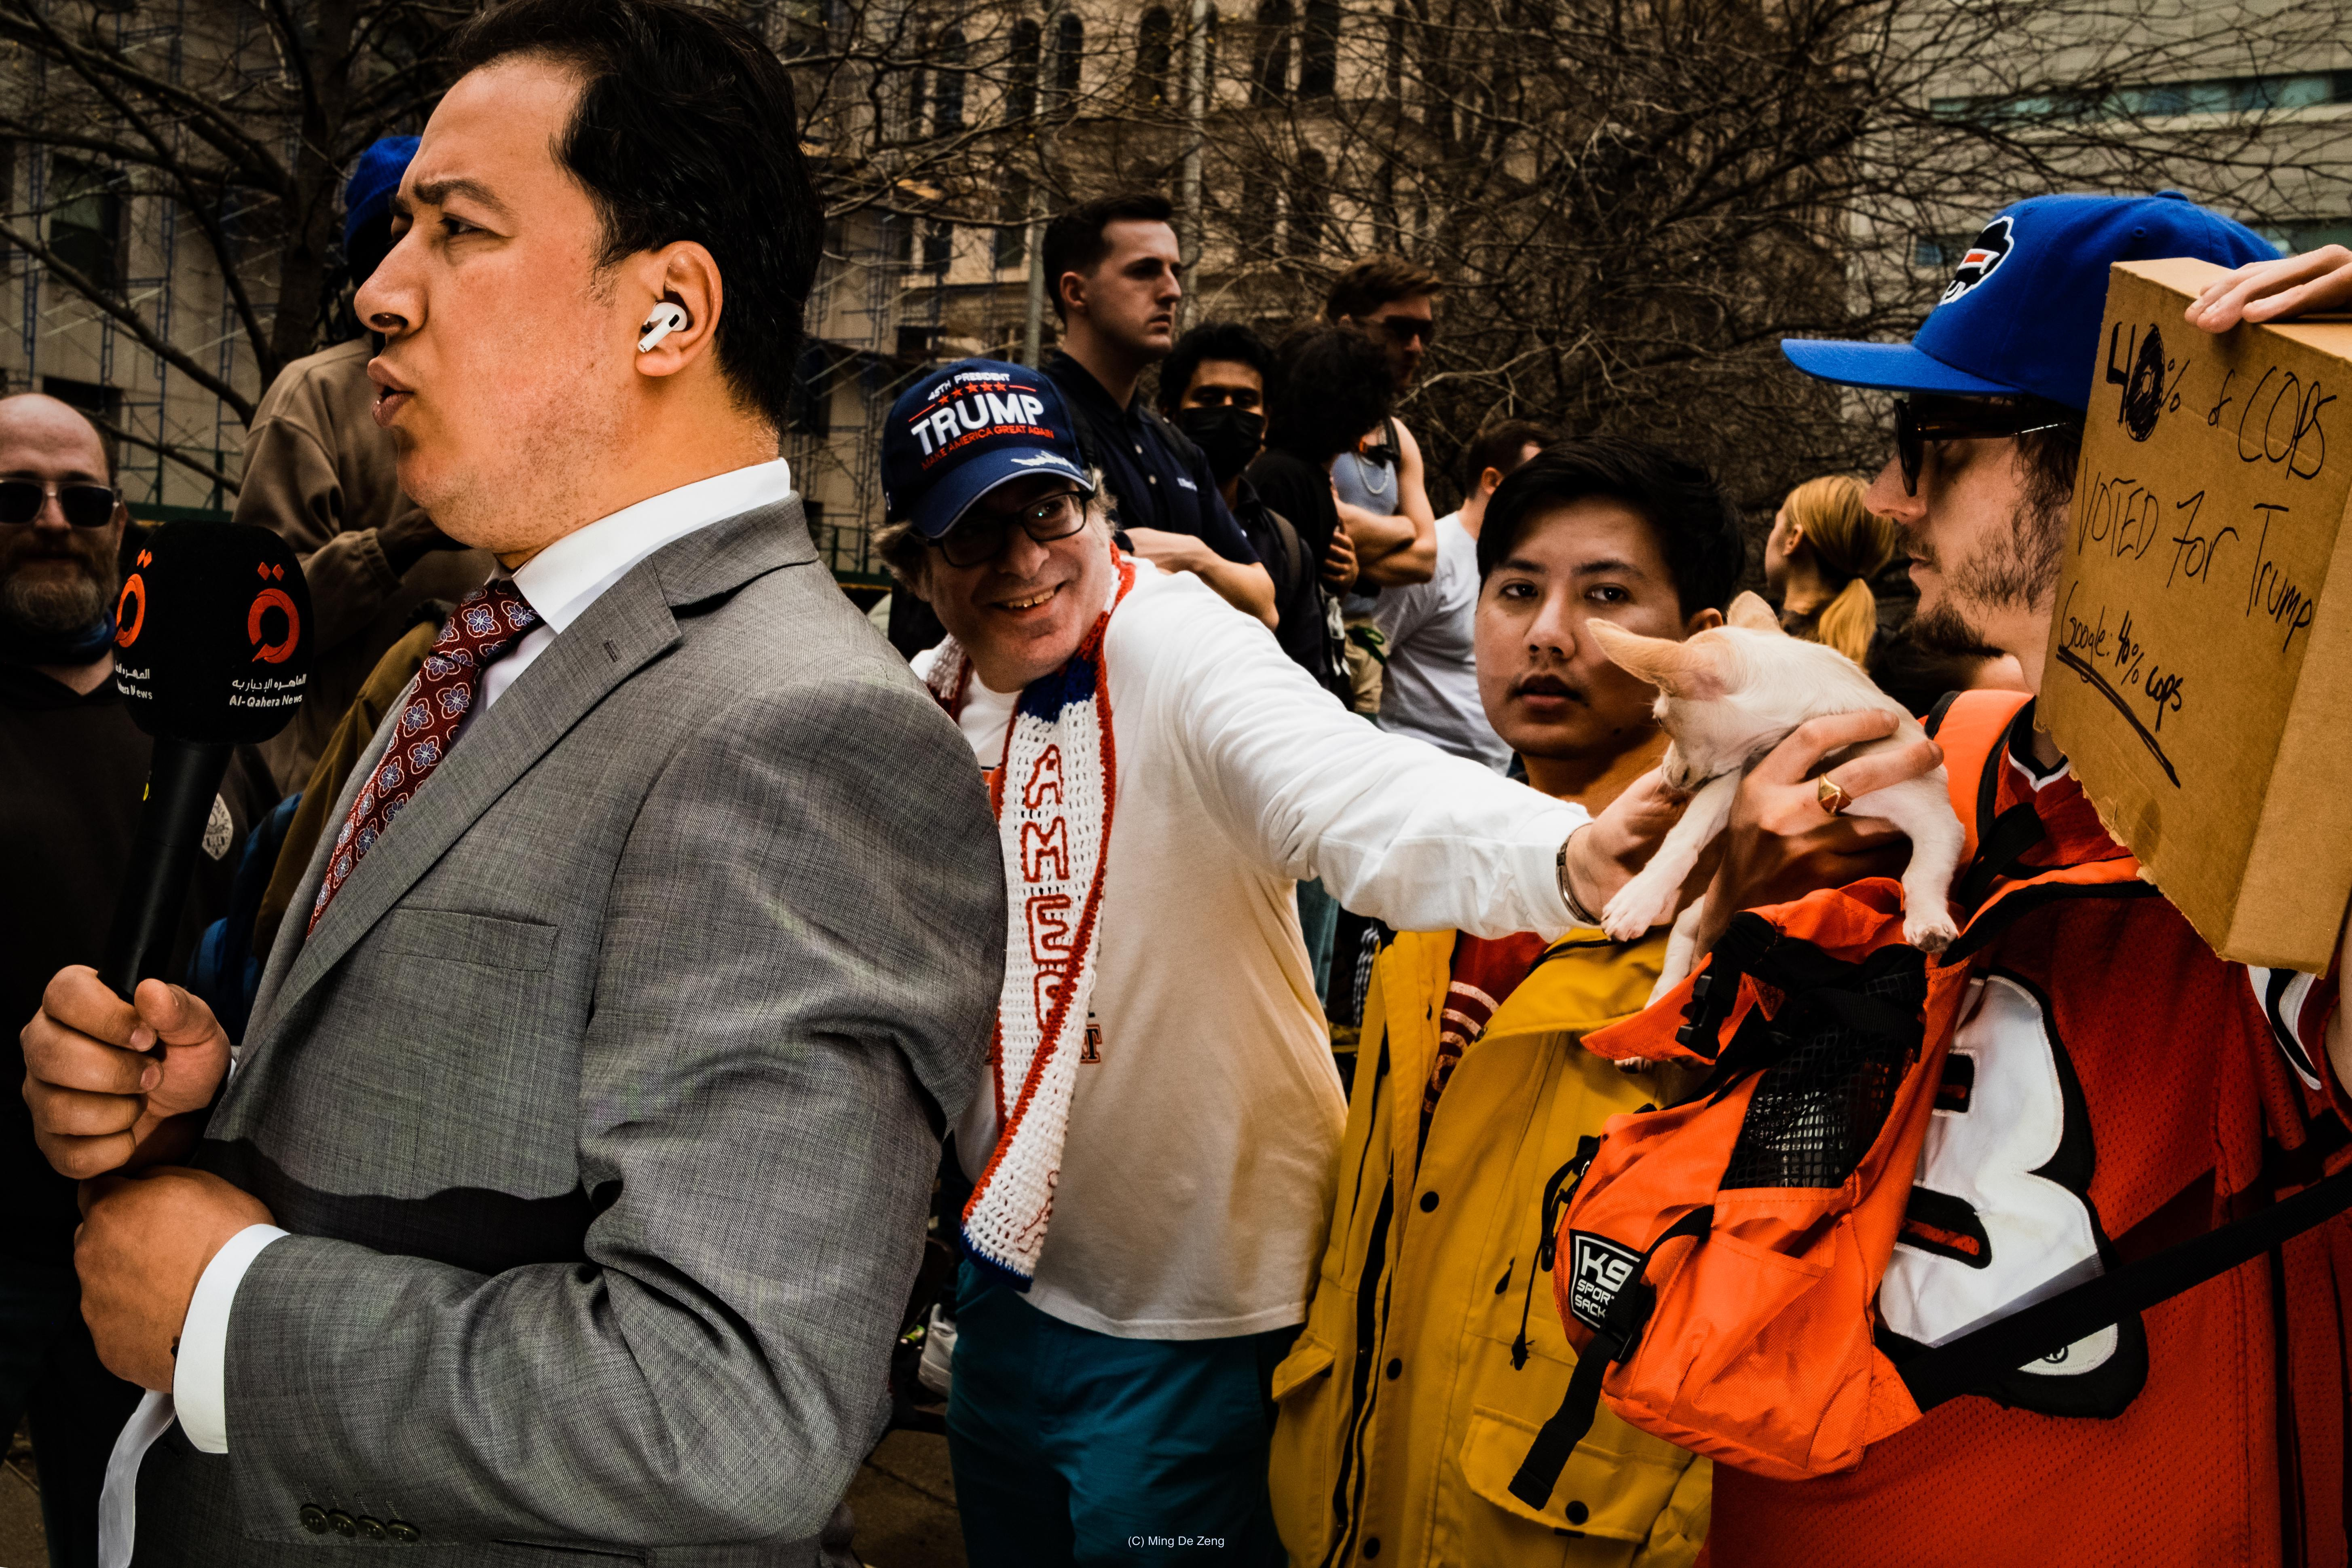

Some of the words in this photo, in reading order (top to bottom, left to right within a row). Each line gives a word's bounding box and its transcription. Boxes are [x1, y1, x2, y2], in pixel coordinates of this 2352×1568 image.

[928, 380, 951, 401] 45TH
[954, 372, 1010, 384] PRESIDENT
[2106, 321, 2190, 442] 40%
[911, 393, 1044, 456] TRUMP
[921, 447, 947, 471] MAKE
[949, 428, 994, 453] AMERICA
[994, 425, 1026, 435] GREAT
[1028, 426, 1054, 439] AGAIN
[2078, 457, 2158, 559] VOTED
[130, 684, 153, 700] News
[229, 695, 280, 708] Al-Qahera
[282, 694, 303, 706] News
[1581, 1246, 1634, 1292] K9
[1575, 1294, 1606, 1319] SACK
[1576, 1279, 1614, 1306] SPOR
